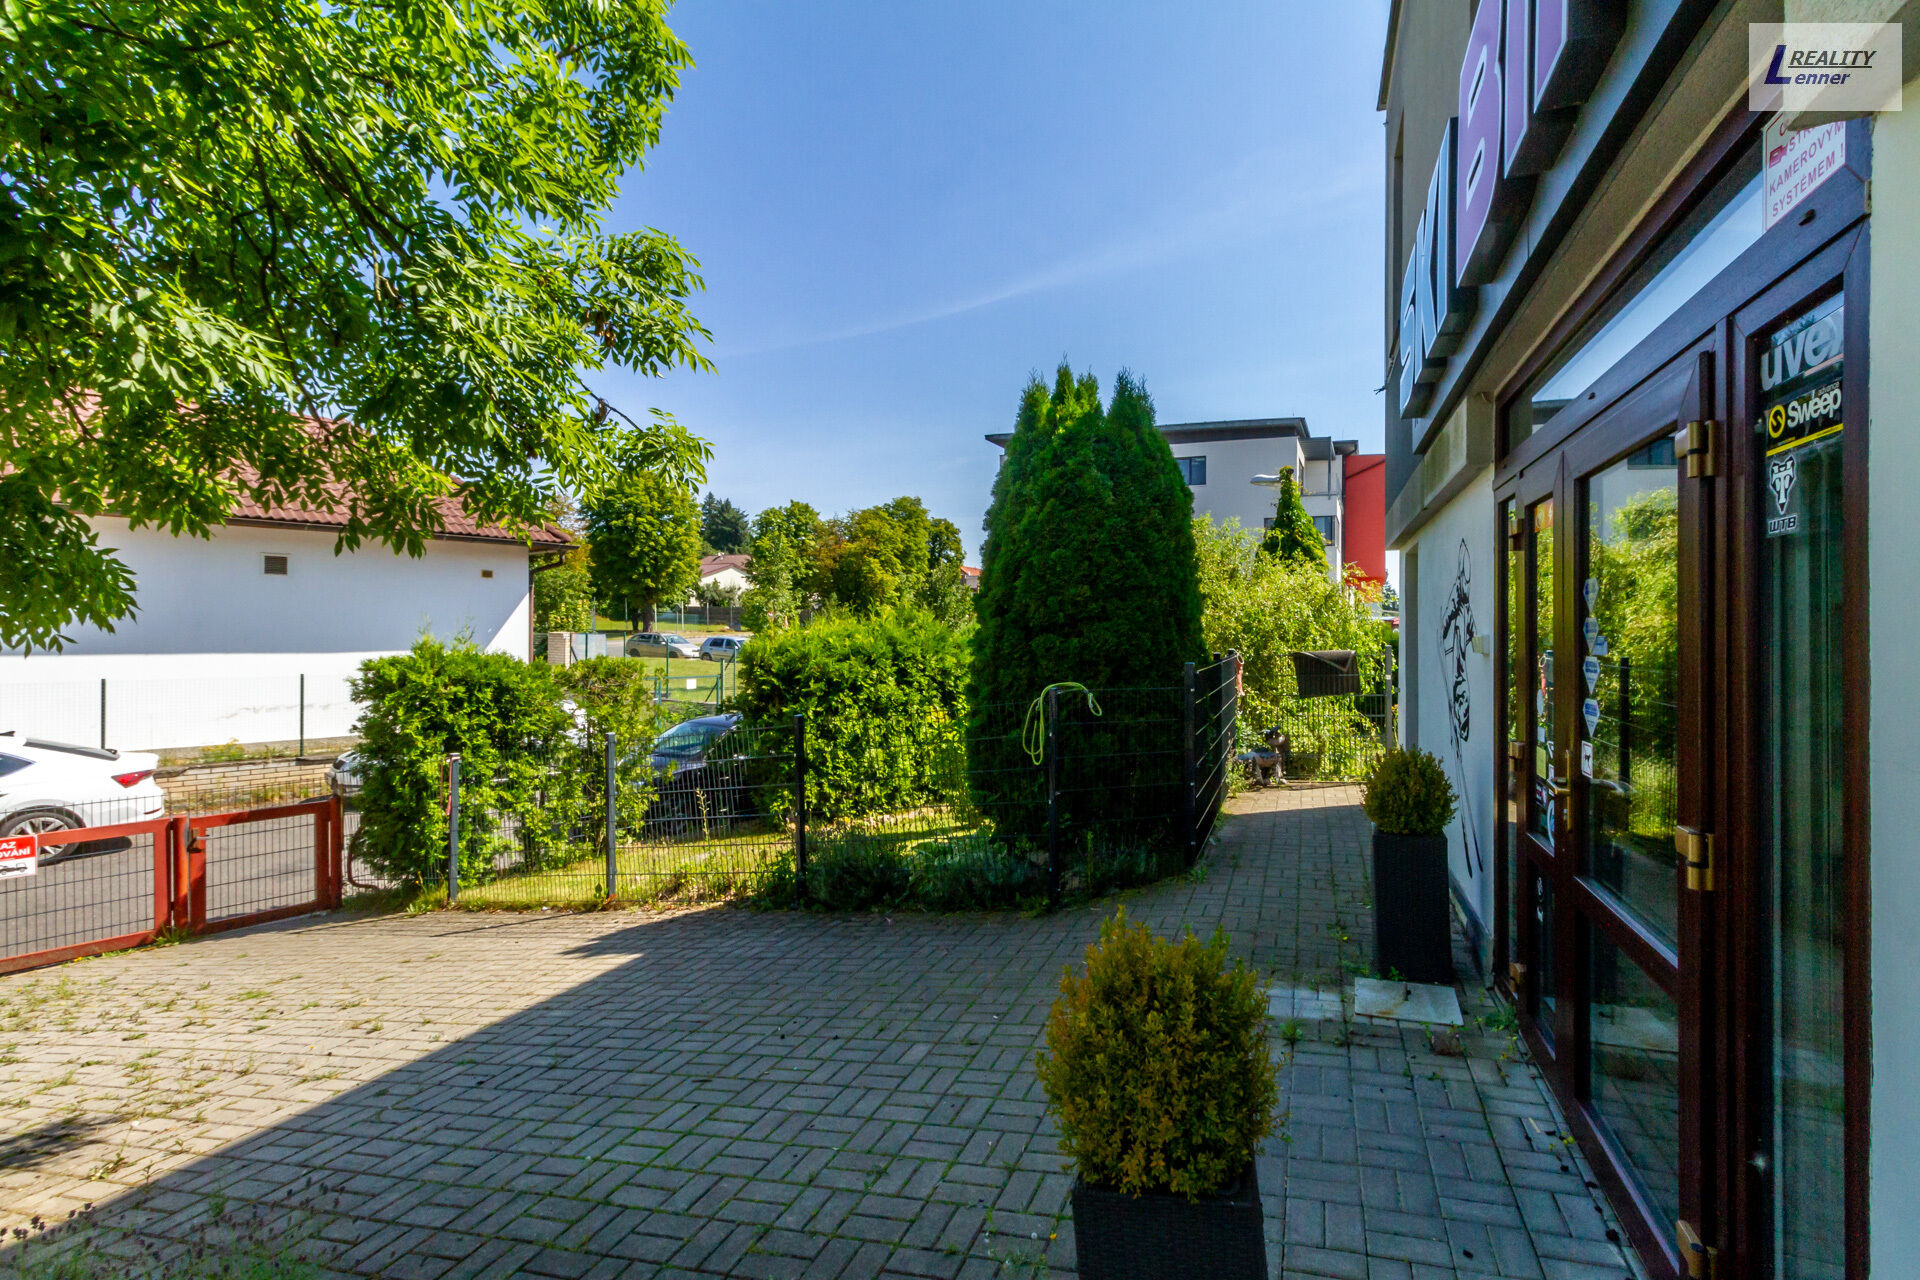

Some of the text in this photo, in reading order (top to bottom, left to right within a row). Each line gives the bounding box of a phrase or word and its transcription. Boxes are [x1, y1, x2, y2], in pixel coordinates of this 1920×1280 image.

[1772, 151, 1836, 217] SYSTÉMEM
[1400, 117, 1450, 419] SKI
[1787, 388, 1842, 428] Sweep
